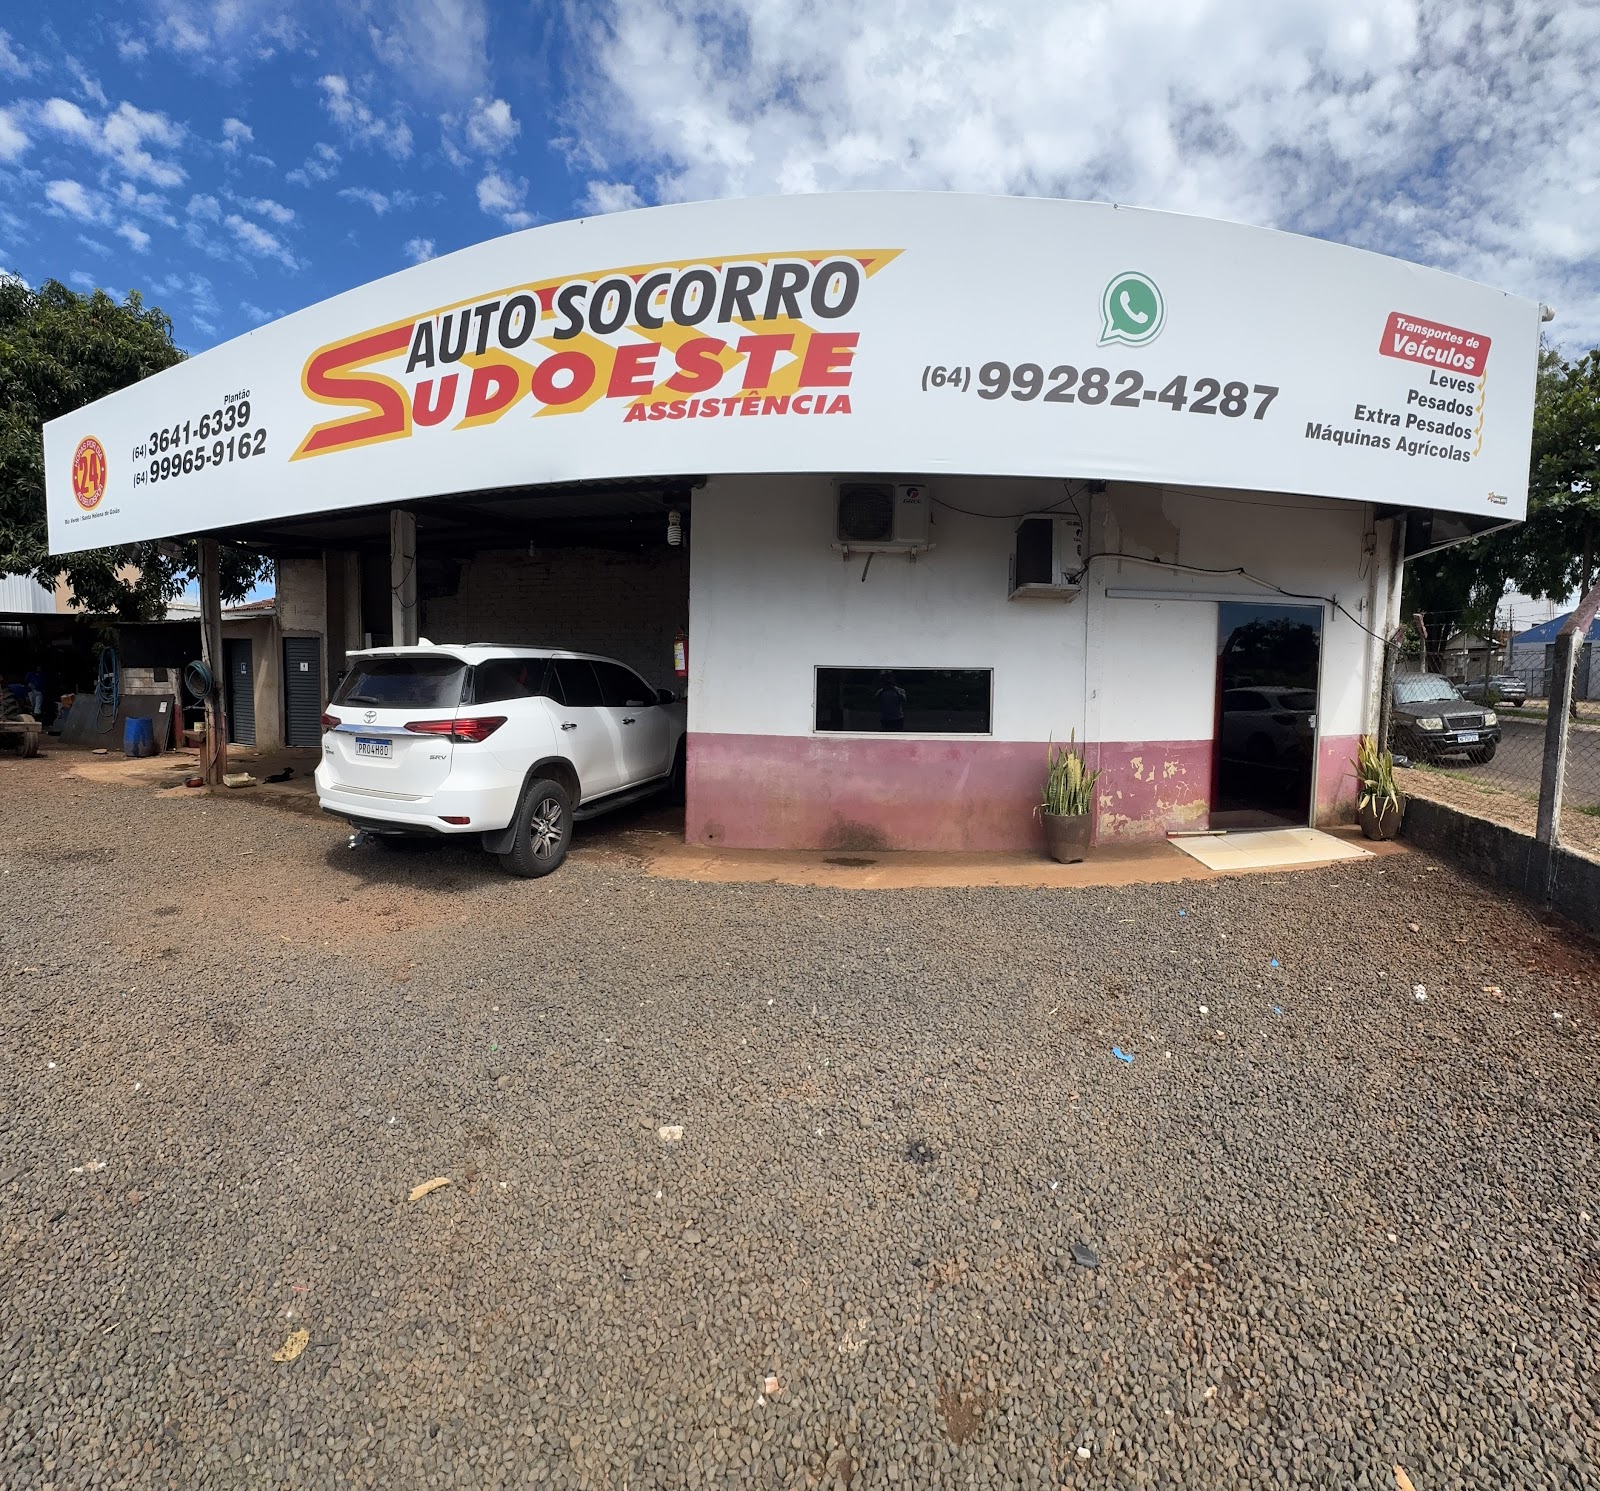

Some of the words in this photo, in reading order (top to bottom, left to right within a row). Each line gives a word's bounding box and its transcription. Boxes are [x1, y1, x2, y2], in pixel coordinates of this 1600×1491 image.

[405, 296, 537, 373] AUTO
[553, 261, 861, 340] SOCORRO
[1396, 317, 1463, 345] Transportes
[1465, 337, 1480, 349] de
[1392, 333, 1476, 370] Veículos
[224, 389, 250, 405] Plantão
[301, 323, 861, 454] SUDOESTE
[921, 366, 971, 392] (64)
[976, 361, 1280, 420] 99282-4287
[1429, 369, 1475, 394] Leves
[623, 391, 852, 423] ASSISTÊNCIA
[1354, 404, 1401, 427] Extra
[1405, 413, 1472, 440] Pesados
[1406, 389, 1474, 417] Pesados
[132, 443, 147, 463] (64)
[149, 400, 251, 456] 3641-6339
[1305, 422, 1391, 450] Máquinas
[1395, 436, 1471, 463] Agrícolas
[79, 453, 99, 494] 24
[133, 470, 148, 489] (64)
[150, 427, 268, 484] 99965-9162
